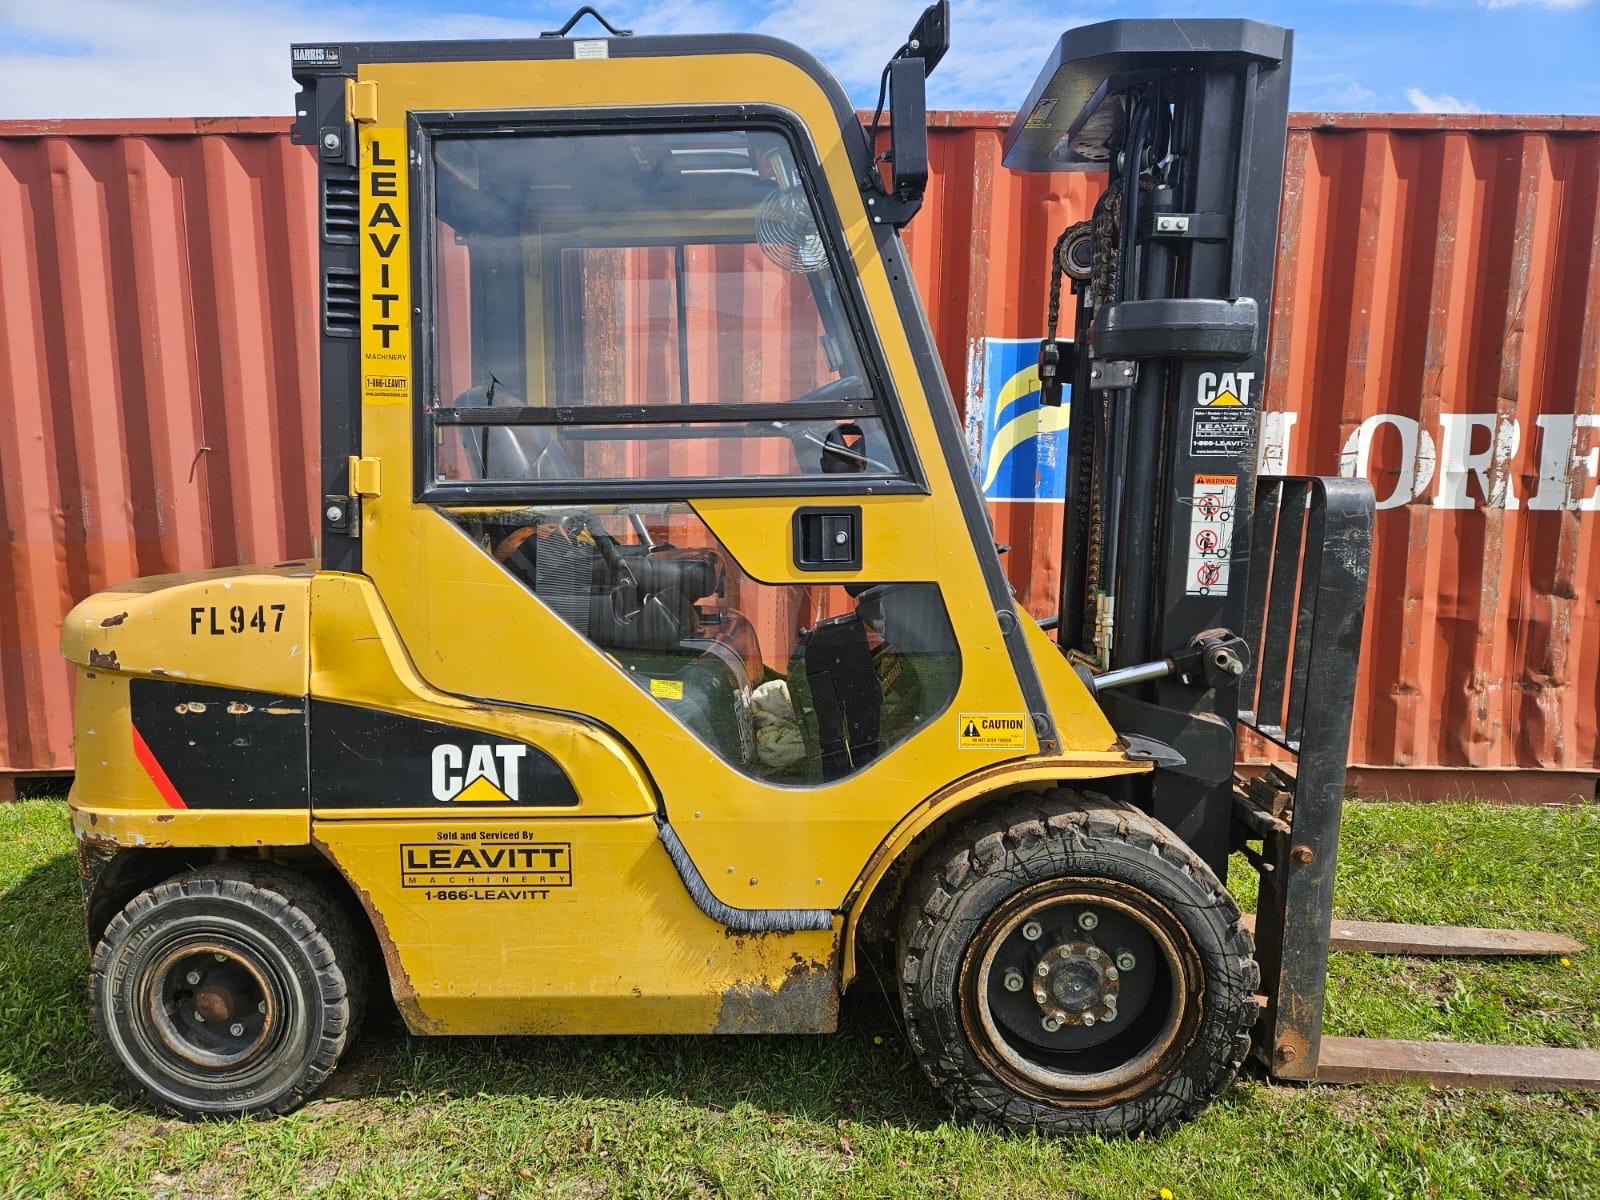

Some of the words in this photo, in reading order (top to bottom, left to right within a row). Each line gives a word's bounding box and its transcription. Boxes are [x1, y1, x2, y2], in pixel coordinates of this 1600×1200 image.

[293, 48, 324, 60] HARRIS
[368, 141, 402, 348] LEAVITT
[365, 353, 407, 361] MACHINERY
[1197, 371, 1255, 406] CAT
[190, 604, 286, 635] FL947
[982, 719, 1023, 729] CAUTION
[431, 743, 527, 802] CAT
[437, 831, 457, 841] Sold
[460, 831, 477, 840] and
[479, 831, 520, 840] Serviced
[522, 831, 534, 841] By
[407, 848, 564, 869] LEAVITT
[408, 875, 565, 884] MACHINERY
[425, 890, 550, 901] 1-866-LEAVITT
